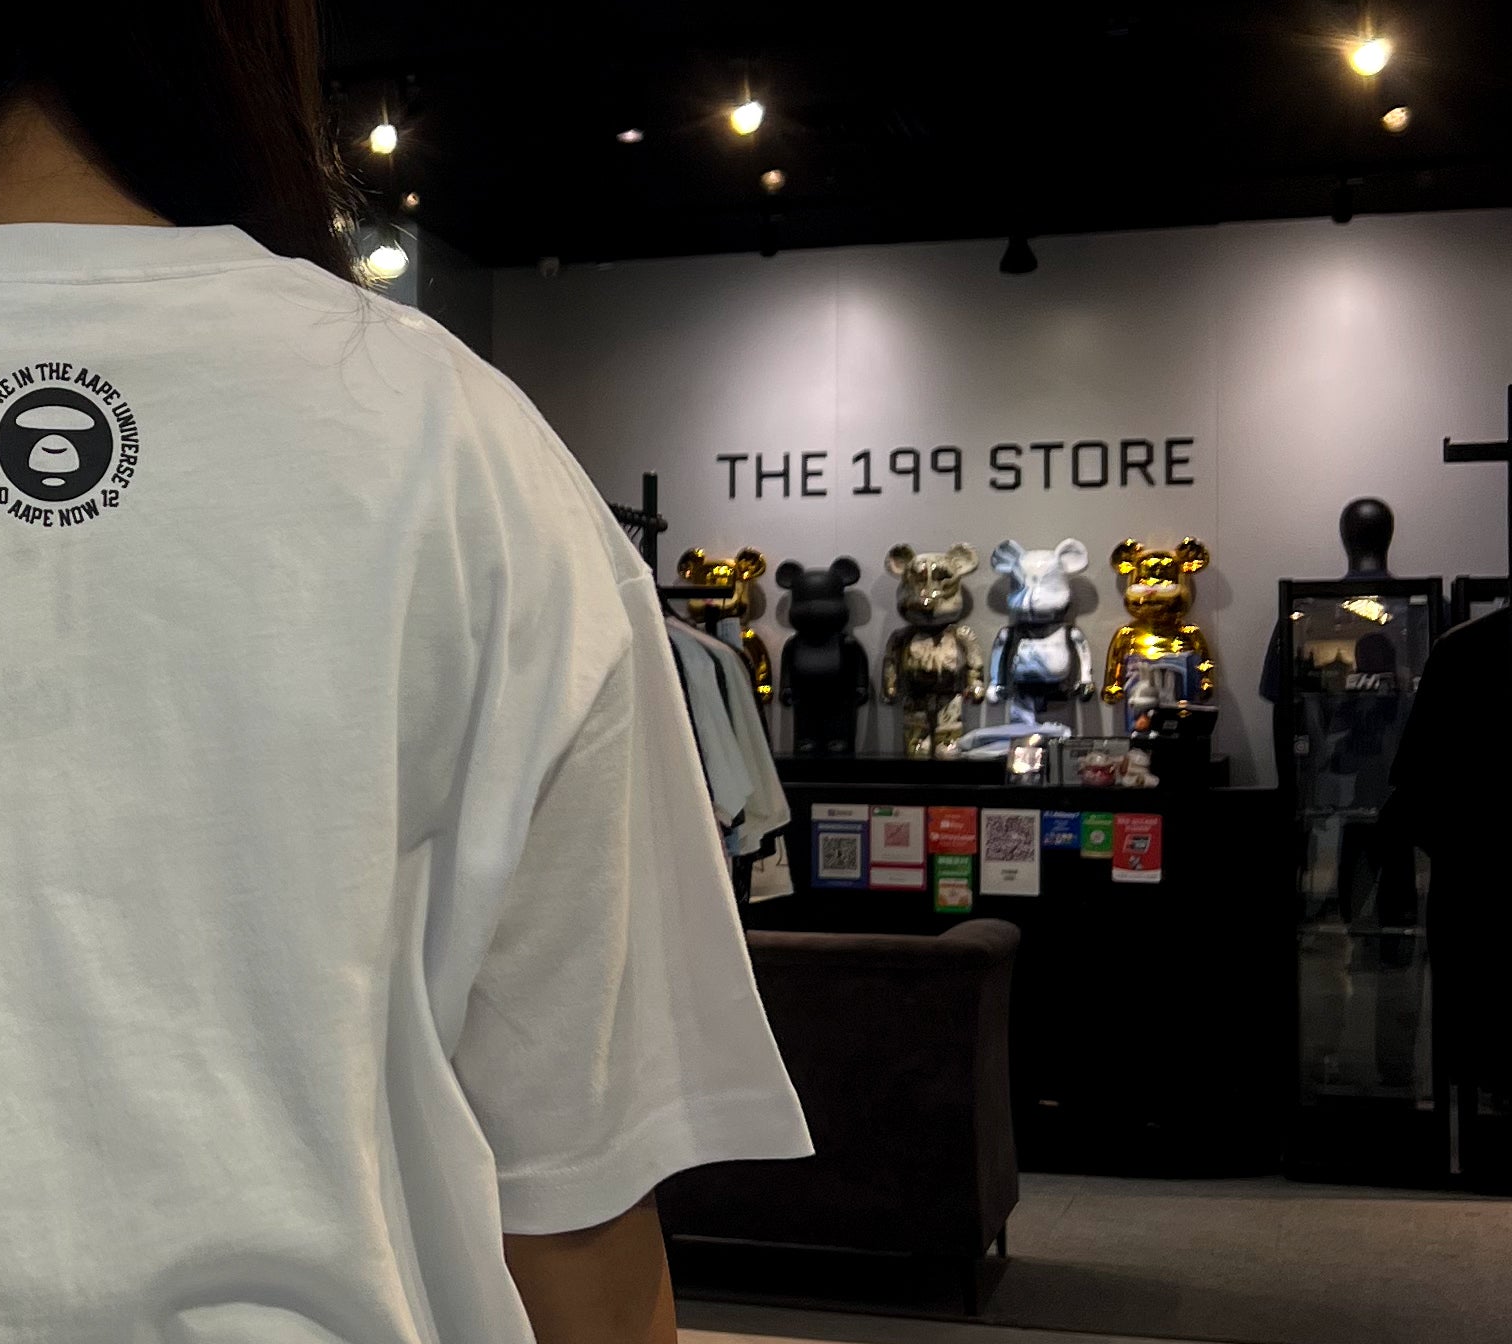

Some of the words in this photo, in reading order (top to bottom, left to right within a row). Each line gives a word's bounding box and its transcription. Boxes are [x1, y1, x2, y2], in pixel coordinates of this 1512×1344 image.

[12, 366, 34, 388] IN
[35, 362, 73, 381] THE
[74, 368, 121, 406] AAPE
[111, 402, 140, 489] UNIVERSE
[716, 449, 829, 499] THE
[851, 444, 963, 496] 199
[989, 436, 1196, 492] STORE
[7, 499, 54, 527] AAPE
[58, 498, 100, 527] NOW
[100, 489, 120, 508] 12
